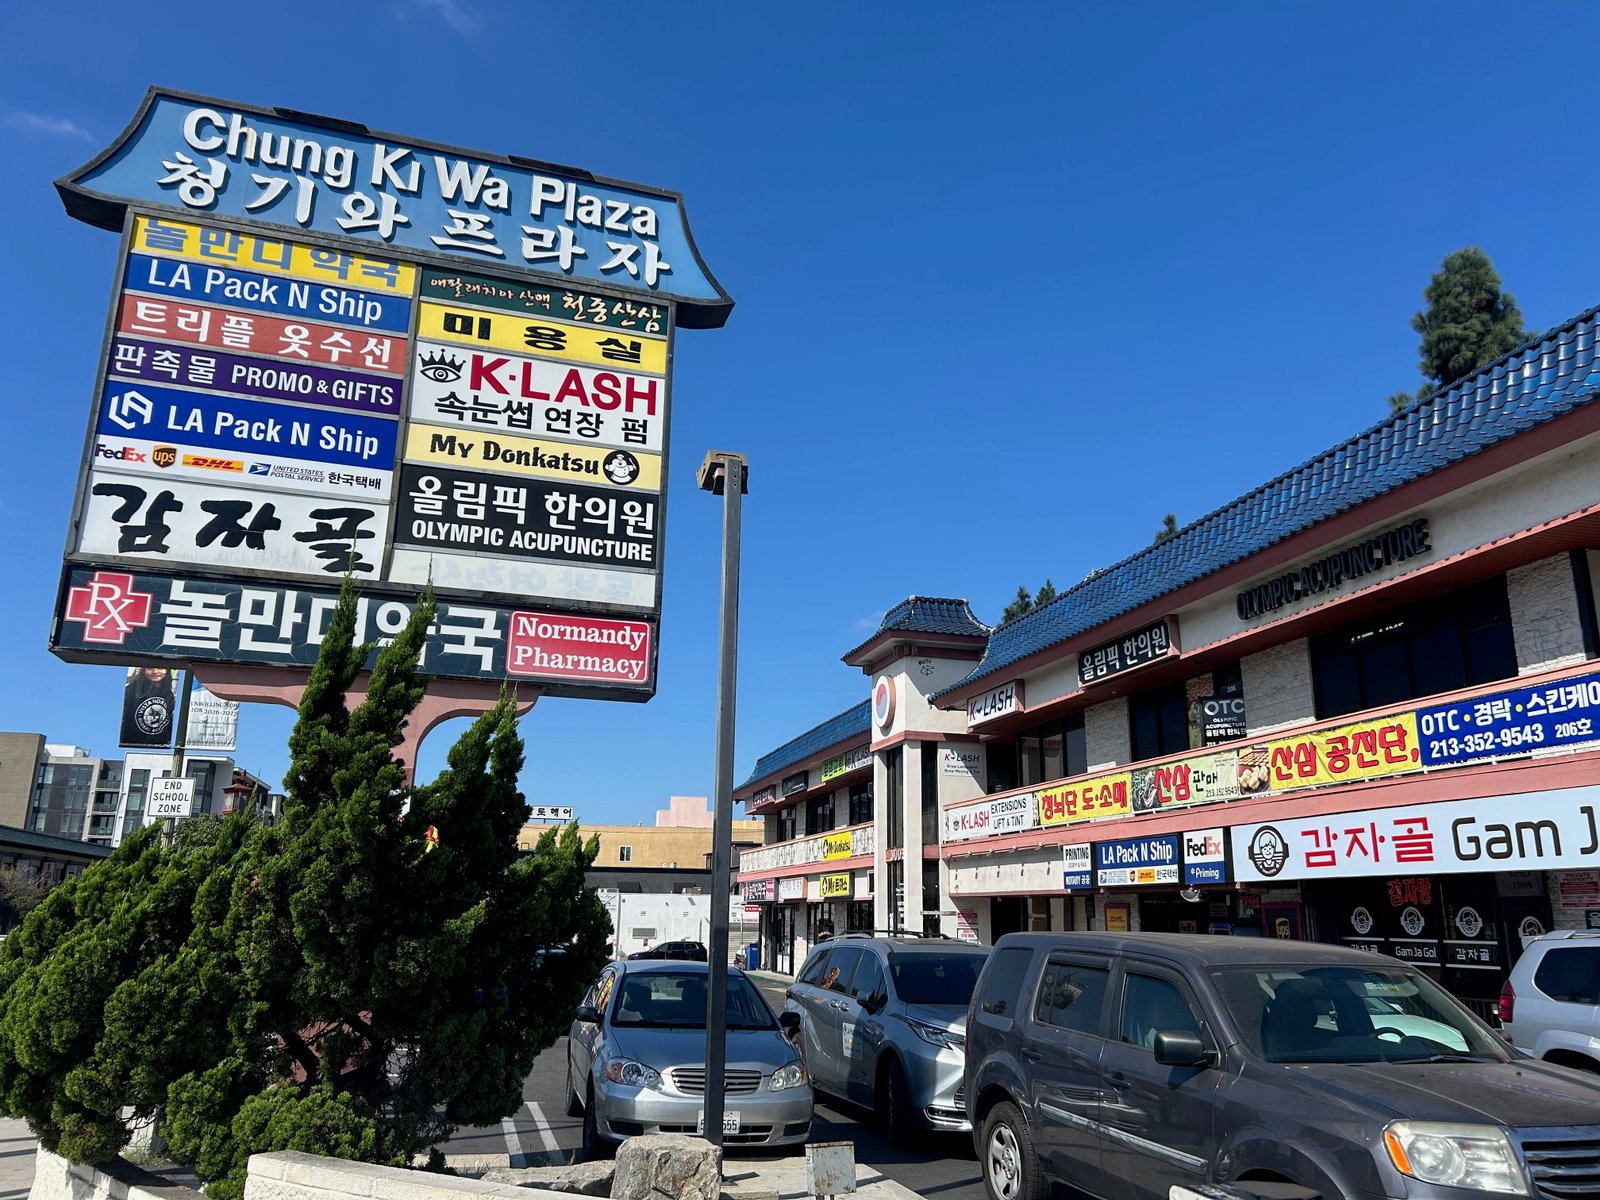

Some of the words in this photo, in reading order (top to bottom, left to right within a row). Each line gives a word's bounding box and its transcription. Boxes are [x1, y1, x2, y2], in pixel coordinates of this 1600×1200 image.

[183, 108, 354, 188] Chung
[371, 143, 423, 192] Ki
[434, 156, 509, 210] Wa
[530, 175, 658, 236] Plaza
[149, 260, 192, 291] LA
[204, 269, 279, 305] Pack
[288, 284, 309, 309] N
[318, 288, 382, 325] Ship
[519, 290, 551, 310] 산맥
[562, 290, 665, 333] 천종산삼
[131, 301, 255, 349] 트리플
[278, 325, 392, 370] 옷수선
[443, 312, 642, 363] 미용실
[114, 344, 216, 385] 판촉물
[231, 365, 313, 395] PROMO
[316, 380, 328, 394] &
[332, 379, 394, 406] GIFTS
[167, 406, 203, 433] LA
[214, 411, 282, 443] Pack
[291, 422, 310, 446] N
[319, 426, 379, 459] Ship
[434, 391, 533, 430] 속눈썹
[544, 407, 604, 439] 연장
[621, 418, 648, 445] 펌
[94, 443, 147, 464] FedEx
[153, 451, 176, 466] ups
[190, 457, 236, 471] DHL
[272, 465, 298, 473] UNITED
[298, 468, 324, 476] STATES
[430, 434, 474, 458] My
[483, 441, 599, 475] Donkatsu
[270, 471, 295, 480] POSTAL
[296, 474, 325, 484] SERVICE
[328, 471, 382, 490] 한국택배
[409, 475, 528, 525] 올림픽
[544, 491, 654, 539] 한의원
[92, 482, 376, 573] 감자골
[411, 520, 504, 546] OLYMPIC
[509, 531, 653, 562] ACUPUNCTURE
[1236, 572, 1300, 620] OLYMPIC
[1300, 518, 1432, 597] ACUPUNCTURE
[516, 616, 646, 651] Normandy
[514, 645, 644, 680] Pharmacy
[1082, 645, 1120, 681] 올림픽
[1123, 625, 1169, 665] 한의원
[1204, 699, 1245, 716] OTC
[1421, 710, 1460, 736] OTC
[1474, 698, 1512, 727] 경락
[1430, 723, 1545, 758] 213-352-9543
[1555, 718, 1594, 738] 206호
[1271, 741, 1317, 781] 산삼
[153, 792, 189, 802] SCHOOL
[164, 781, 182, 790] END
[1154, 763, 1191, 803] 산삼
[1193, 770, 1218, 792] 판매
[157, 804, 182, 813] ZONE
[991, 798, 1026, 814] EXTENSIONS
[994, 817, 1005, 829] LIFT
[1006, 819, 1010, 827] &
[1012, 815, 1025, 827] TINT
[1065, 846, 1089, 861] PRINTING
[1102, 846, 1114, 865] LA
[1117, 844, 1139, 864] Pack
[1141, 842, 1148, 861] N
[1150, 840, 1172, 863] Ship
[1186, 836, 1221, 857] FedEx
[1301, 817, 1434, 868] 감자골
[1451, 816, 1562, 861] Gam
[1395, 946, 1413, 957] Gam
[1423, 946, 1437, 958] Gol
[1455, 947, 1490, 961] 감자골
